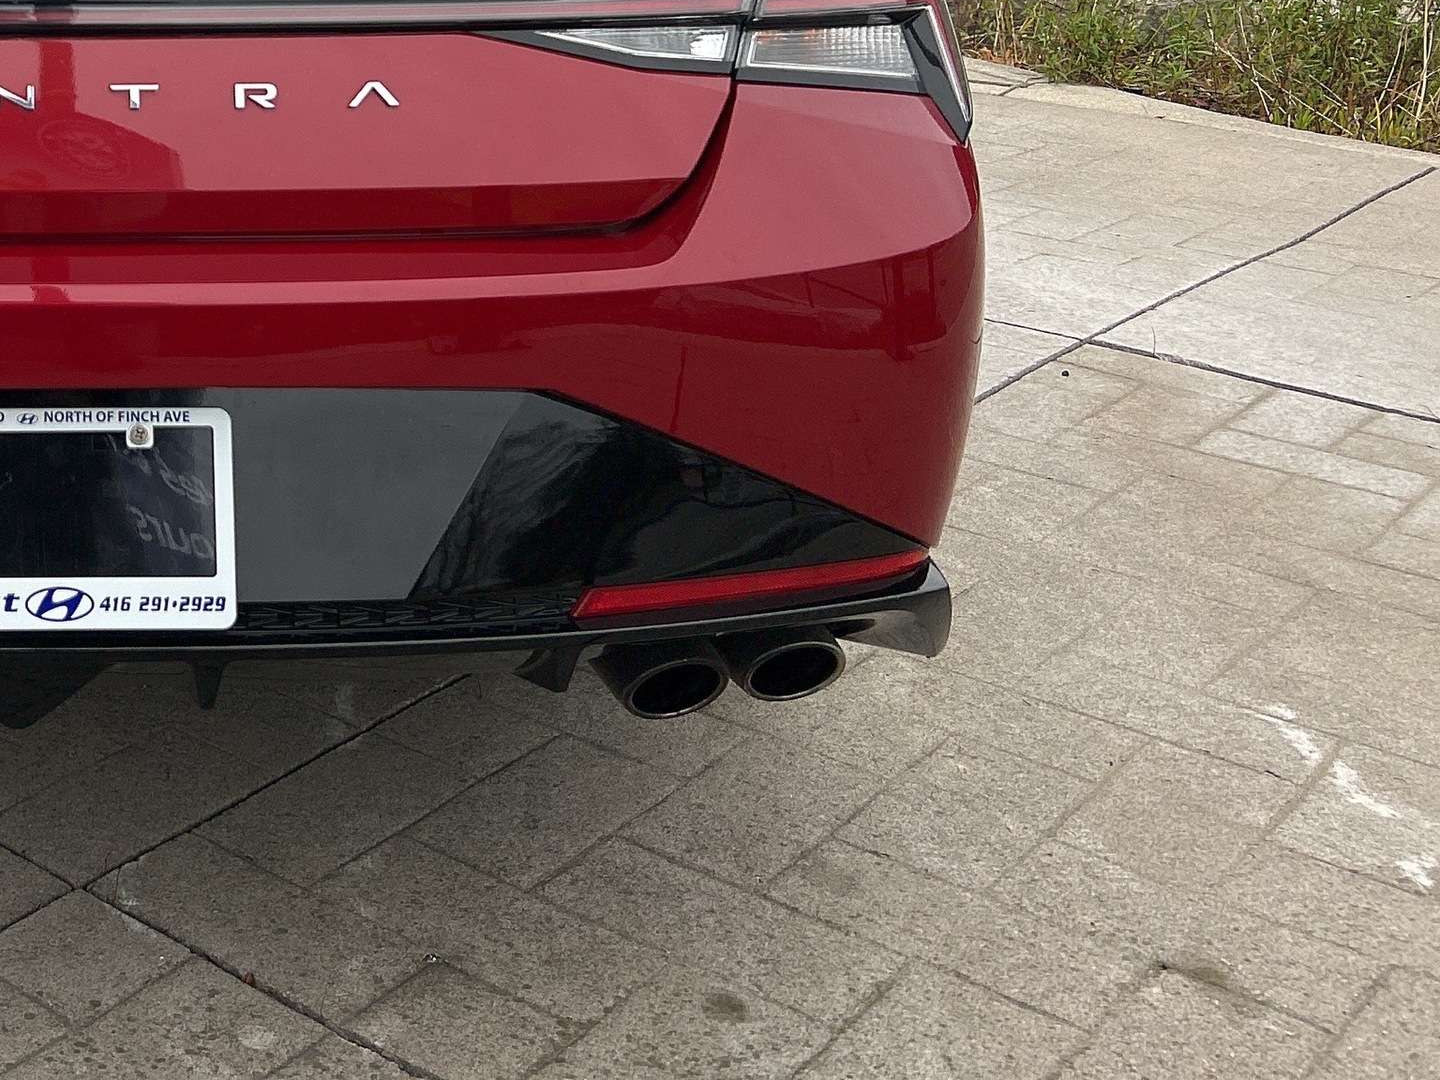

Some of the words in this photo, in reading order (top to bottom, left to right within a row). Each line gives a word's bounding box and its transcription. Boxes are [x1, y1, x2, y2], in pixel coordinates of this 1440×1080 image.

[44, 410, 92, 423] NORTH
[95, 410, 114, 422] OF
[118, 410, 160, 422] FINCH
[163, 410, 191, 422] AVE
[99, 595, 132, 612] 416
